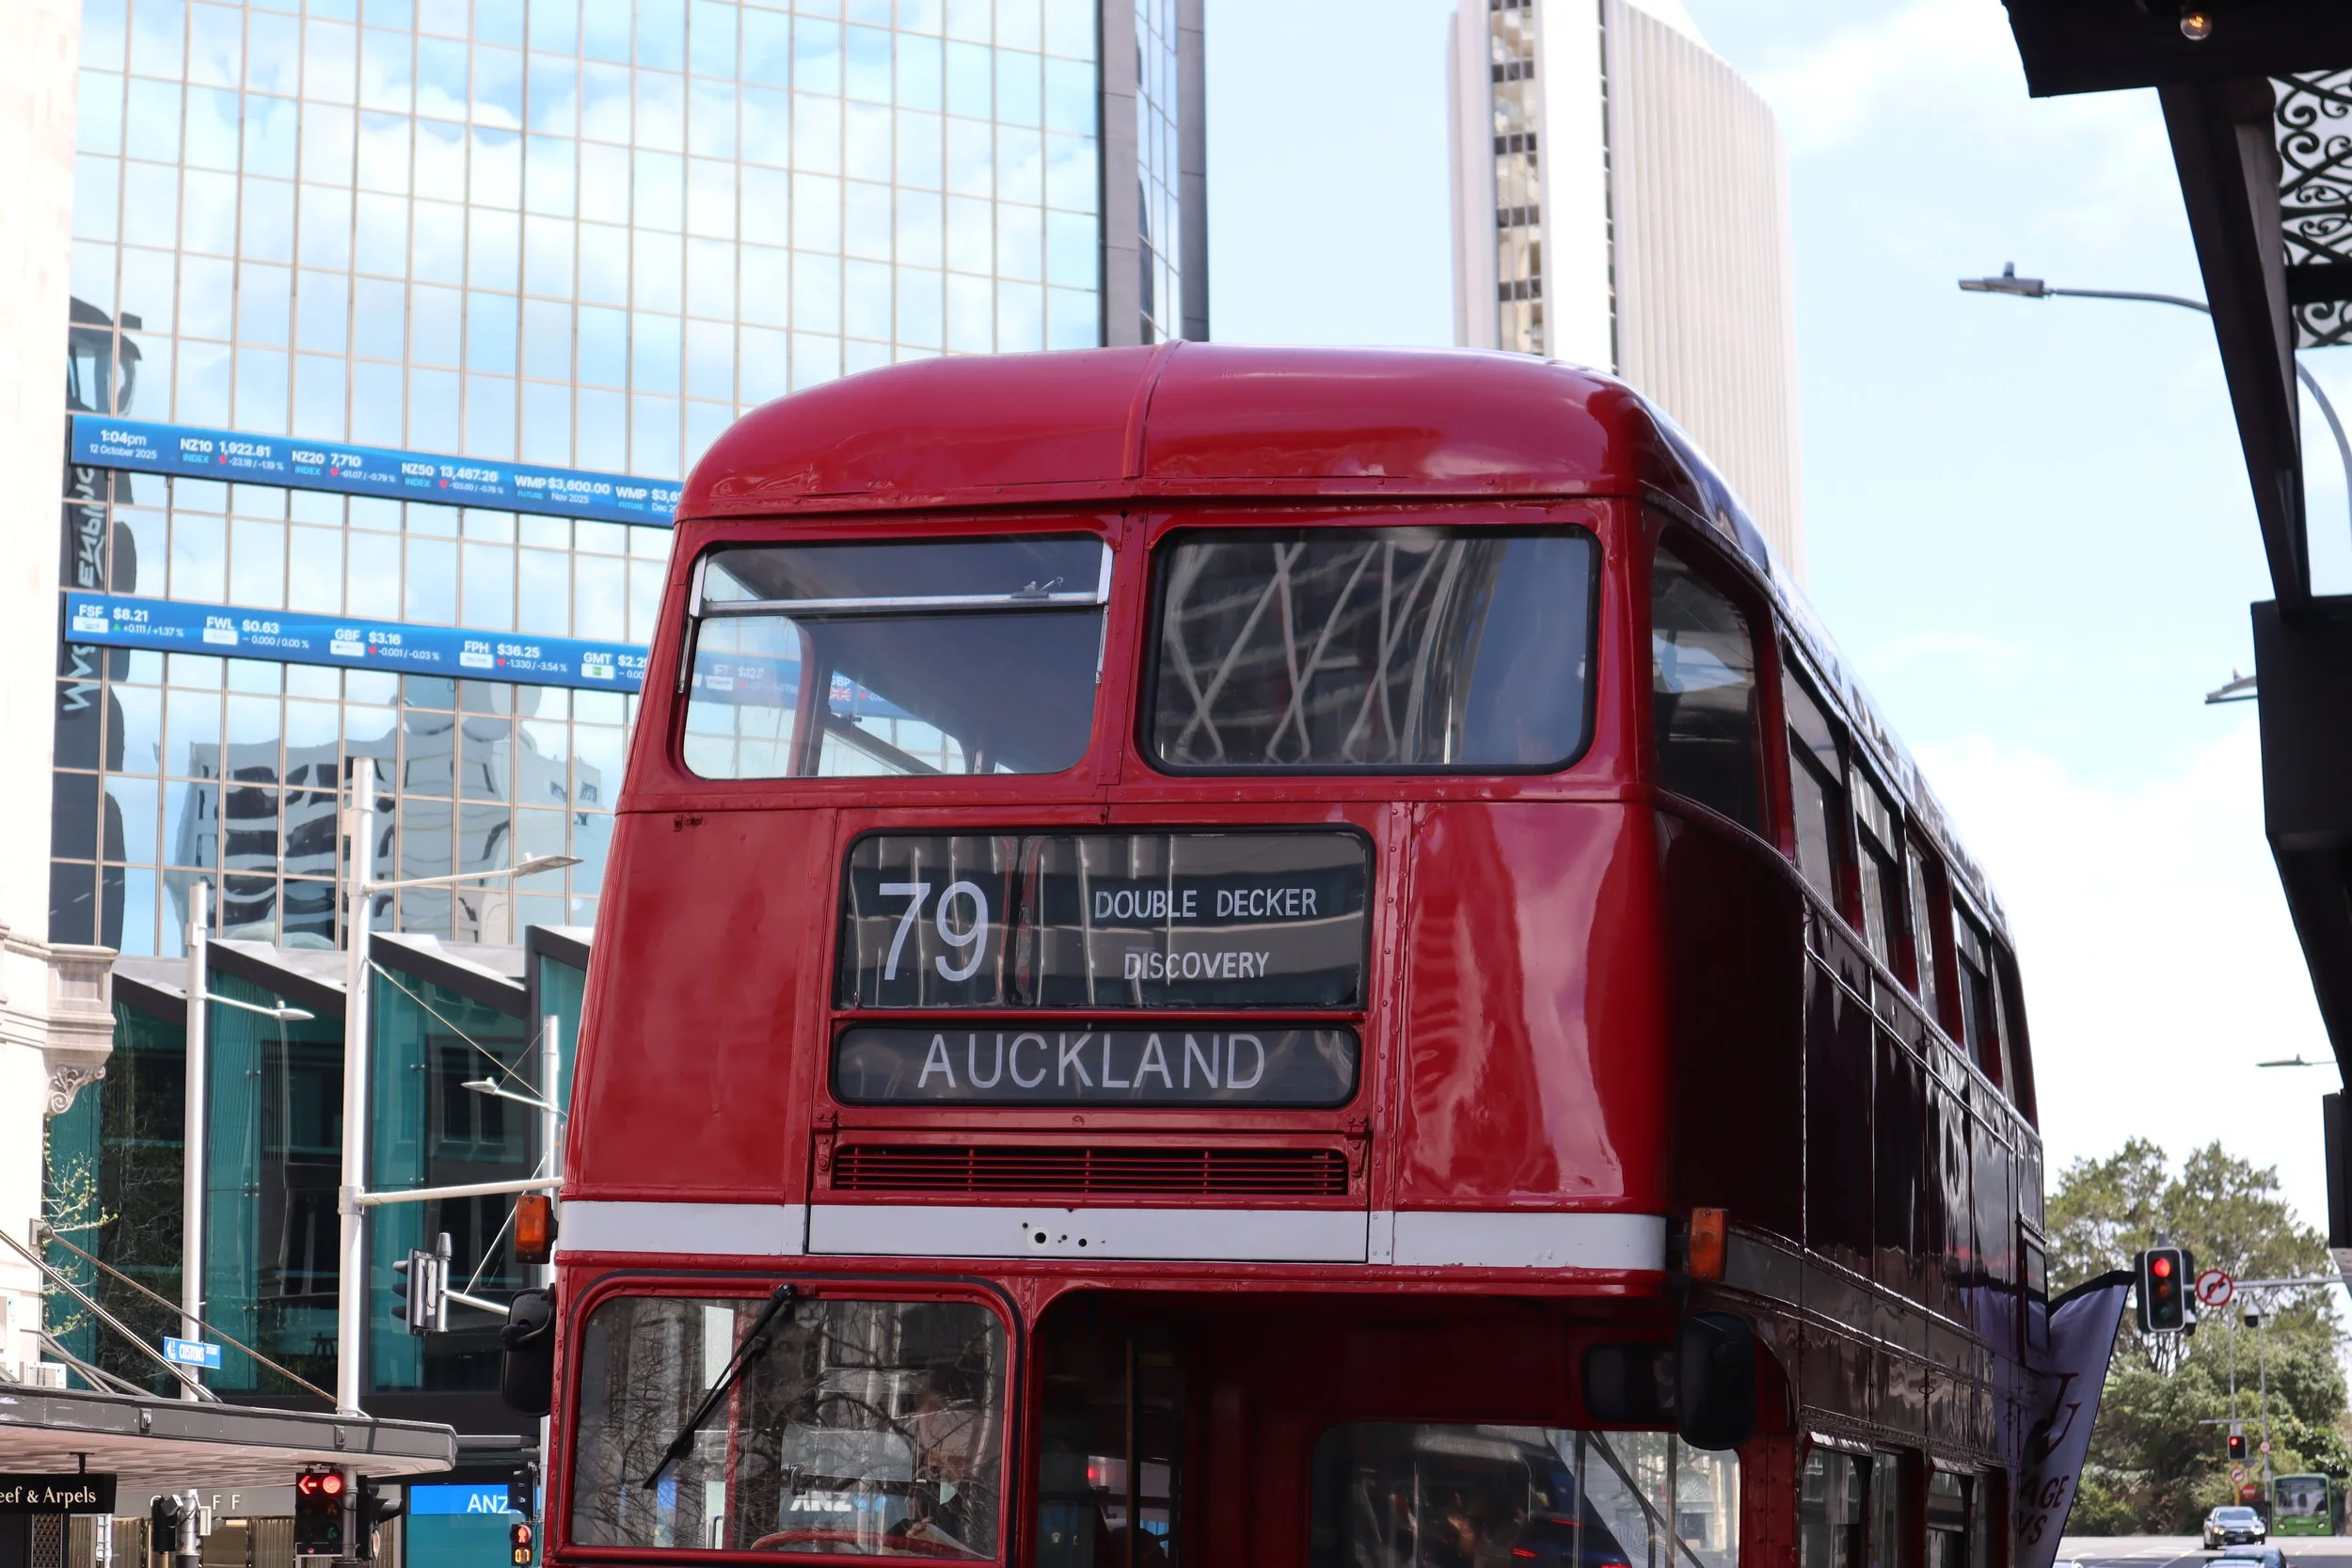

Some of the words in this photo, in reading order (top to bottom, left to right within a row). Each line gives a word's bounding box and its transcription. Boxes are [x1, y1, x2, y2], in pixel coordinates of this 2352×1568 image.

[101, 429, 147, 447] 1:04pm
[89, 444, 99, 453] 12
[100, 446, 133, 457] October
[135, 449, 157, 460] 2025
[180, 437, 213, 453] NZ10
[219, 440, 272, 458] 1,922.81
[183, 453, 209, 465] INDEX
[292, 451, 325, 465] NZ20
[330, 452, 362, 467] 7,710
[294, 466, 321, 476] INDEX
[401, 462, 434, 477] NZ50
[439, 466, 498, 483] 13,467.26
[405, 477, 431, 487] INDEX
[514, 475, 546, 489] WMP
[548, 477, 611, 495] $3,600.00
[517, 489, 543, 500] FUTURE
[551, 492, 567, 502] Nov
[569, 494, 590, 504] 2025
[615, 485, 647, 500] WMP
[652, 502, 668, 513] Dec
[79, 604, 103, 618] FSF
[113, 606, 149, 623] $8.21
[152, 626, 175, 637] +1.37
[206, 616, 235, 630] FWL
[242, 619, 279, 634] $0.63
[251, 635, 276, 646] 0.000
[281, 638, 300, 648] 0.00
[334, 627, 360, 641] GBF
[368, 630, 402, 645] $3.16
[378, 647, 403, 657] -0.001
[409, 650, 430, 660] -0.03
[464, 641, 489, 653] FPH
[497, 642, 540, 658] $36.25
[506, 658, 532, 670] -1.330
[537, 661, 559, 672] -3.54
[583, 652, 612, 665] GMT
[1094, 889, 1197, 919] DOUBLE
[1216, 888, 1317, 918] DECKER
[879, 880, 988, 982] 79
[1124, 951, 1270, 981] DISCOVERY
[917, 1032, 1265, 1090] AUCKLAND
[179, 1343, 204, 1363] CUSTOMS
[26, 1489, 39, 1503] &
[42, 1485, 97, 1509] Arpels
[467, 1493, 511, 1513] ANZ
[789, 1490, 851, 1512] ANZ
